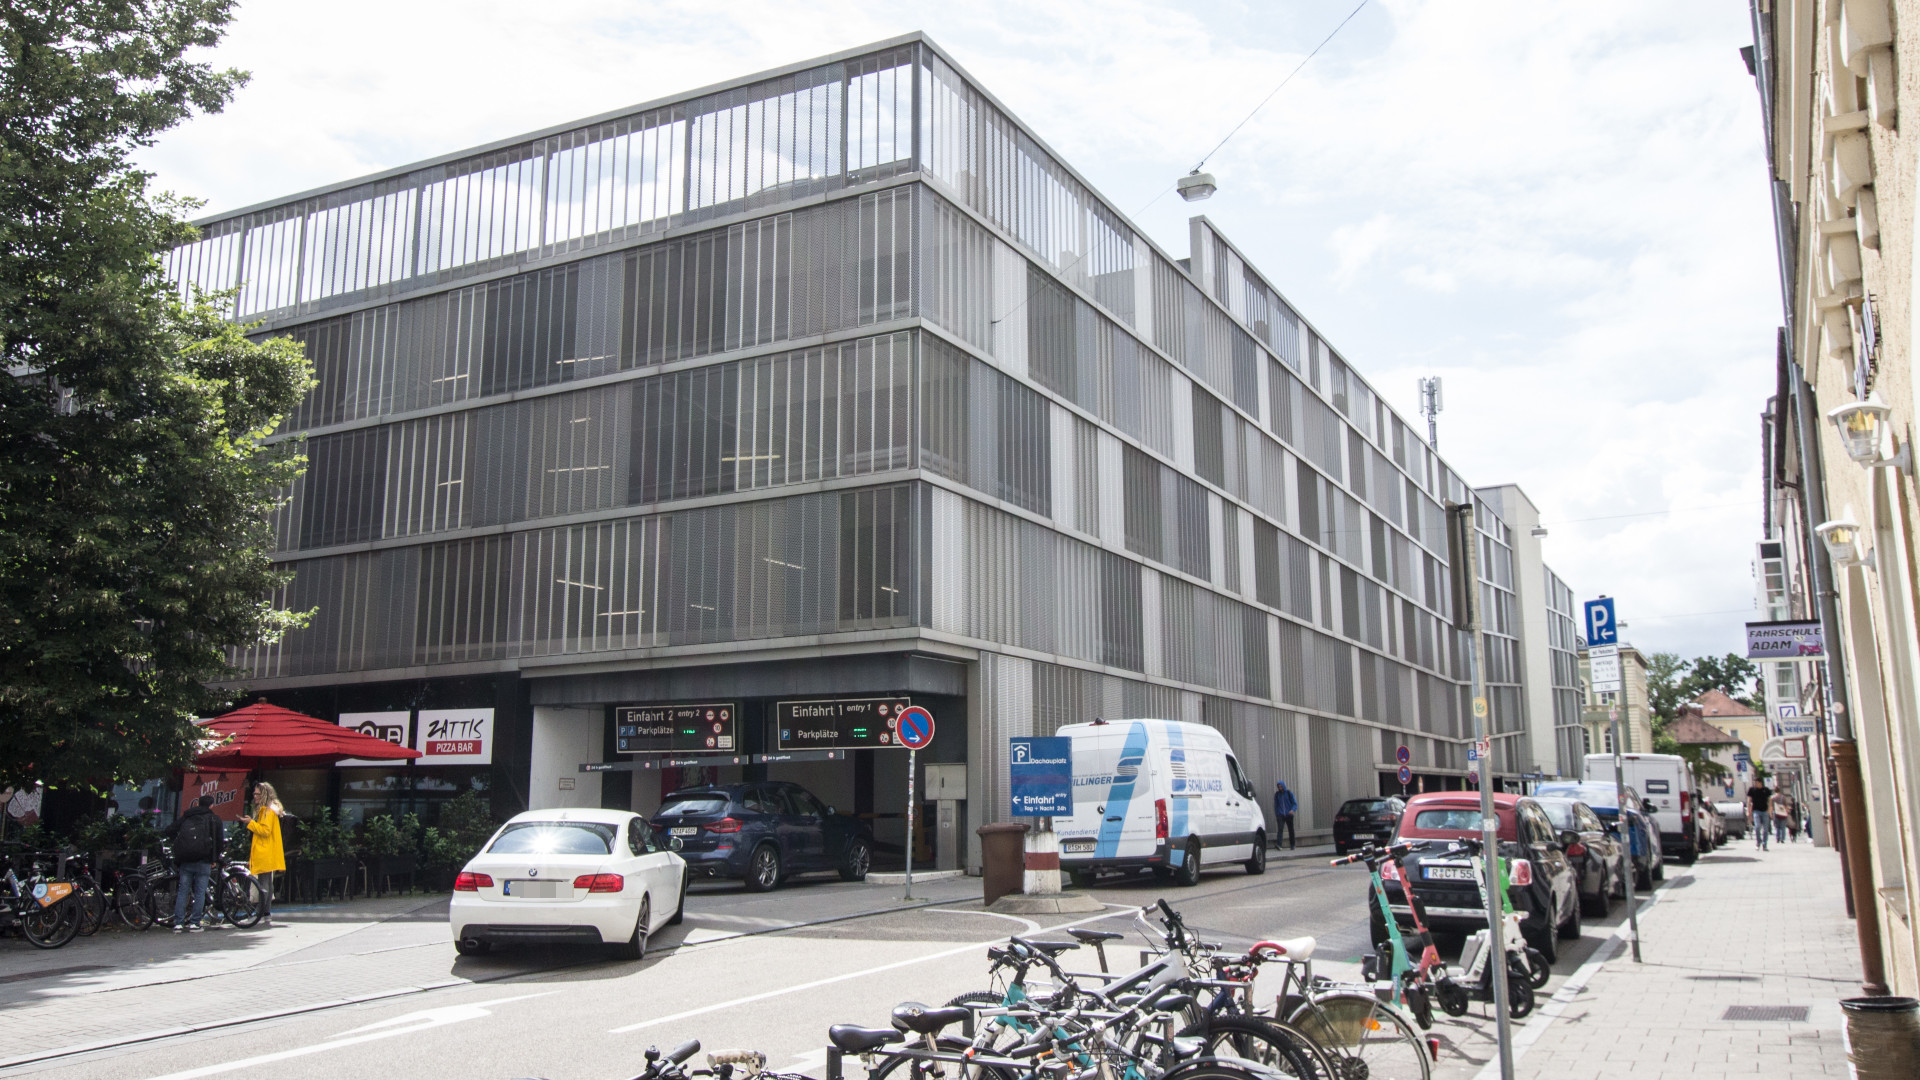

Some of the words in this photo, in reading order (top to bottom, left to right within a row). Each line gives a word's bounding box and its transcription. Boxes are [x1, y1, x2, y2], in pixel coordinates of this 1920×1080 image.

[1591, 605, 1608, 640] P
[1749, 626, 1822, 638] FAHRSCHULE
[1751, 641, 1792, 651] ADAM
[627, 711, 664, 722] Einfahrt
[668, 710, 674, 720] 2
[678, 711, 695, 719] entry
[696, 709, 700, 717] 2
[792, 706, 834, 718] Einfahrt
[838, 705, 843, 715] 1
[847, 705, 866, 713] entry
[427, 718, 484, 740] ZATTIS
[621, 727, 626, 735] P
[638, 726, 674, 736] Parkplätze
[798, 730, 839, 740] Parkplätze
[436, 743, 456, 753] PIZZA
[457, 742, 473, 753] BAR
[1017, 750, 1025, 762] P
[200, 780, 219, 797] CITY
[1188, 779, 1222, 792] SCHILLINGER
[1024, 796, 1054, 805] Einfahrt
[1057, 829, 1098, 837] Kundendienst
[1432, 868, 1438, 877] R
[1444, 868, 1456, 878] CT
